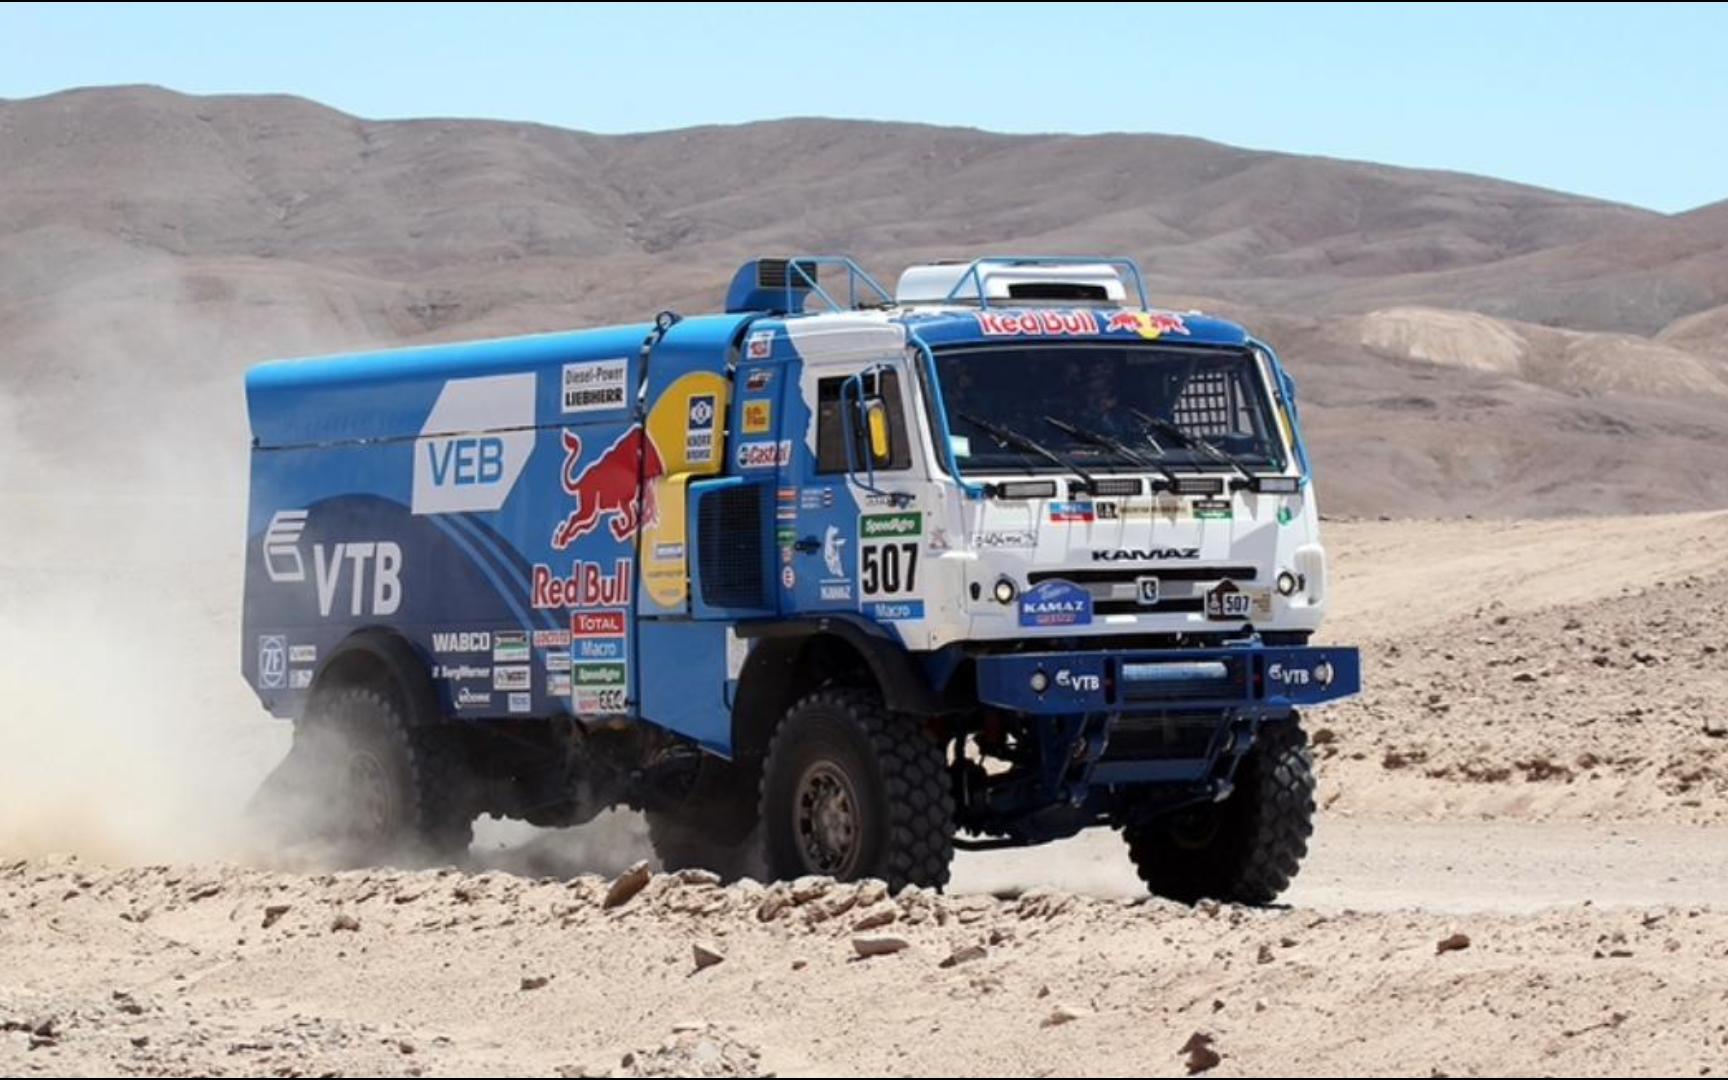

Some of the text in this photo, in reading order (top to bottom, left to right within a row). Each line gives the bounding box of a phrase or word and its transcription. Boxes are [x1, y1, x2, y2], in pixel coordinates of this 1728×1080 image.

[980, 309, 1099, 334] Red Bull
[565, 387, 624, 406] LIEBHERR
[428, 437, 504, 486] VEB
[1092, 548, 1200, 561] KAMAZ
[862, 543, 918, 595] 507
[314, 542, 402, 616] VTB
[532, 558, 631, 609] Red Bull
[874, 604, 911, 618] Macro
[1023, 600, 1084, 613] KAMAZ
[1226, 595, 1250, 612] 507
[578, 613, 619, 630] TOTAL
[432, 632, 490, 652] WABCO
[580, 640, 617, 657] Macro
[1072, 675, 1100, 691] VTB
[1281, 668, 1309, 684] VTB
